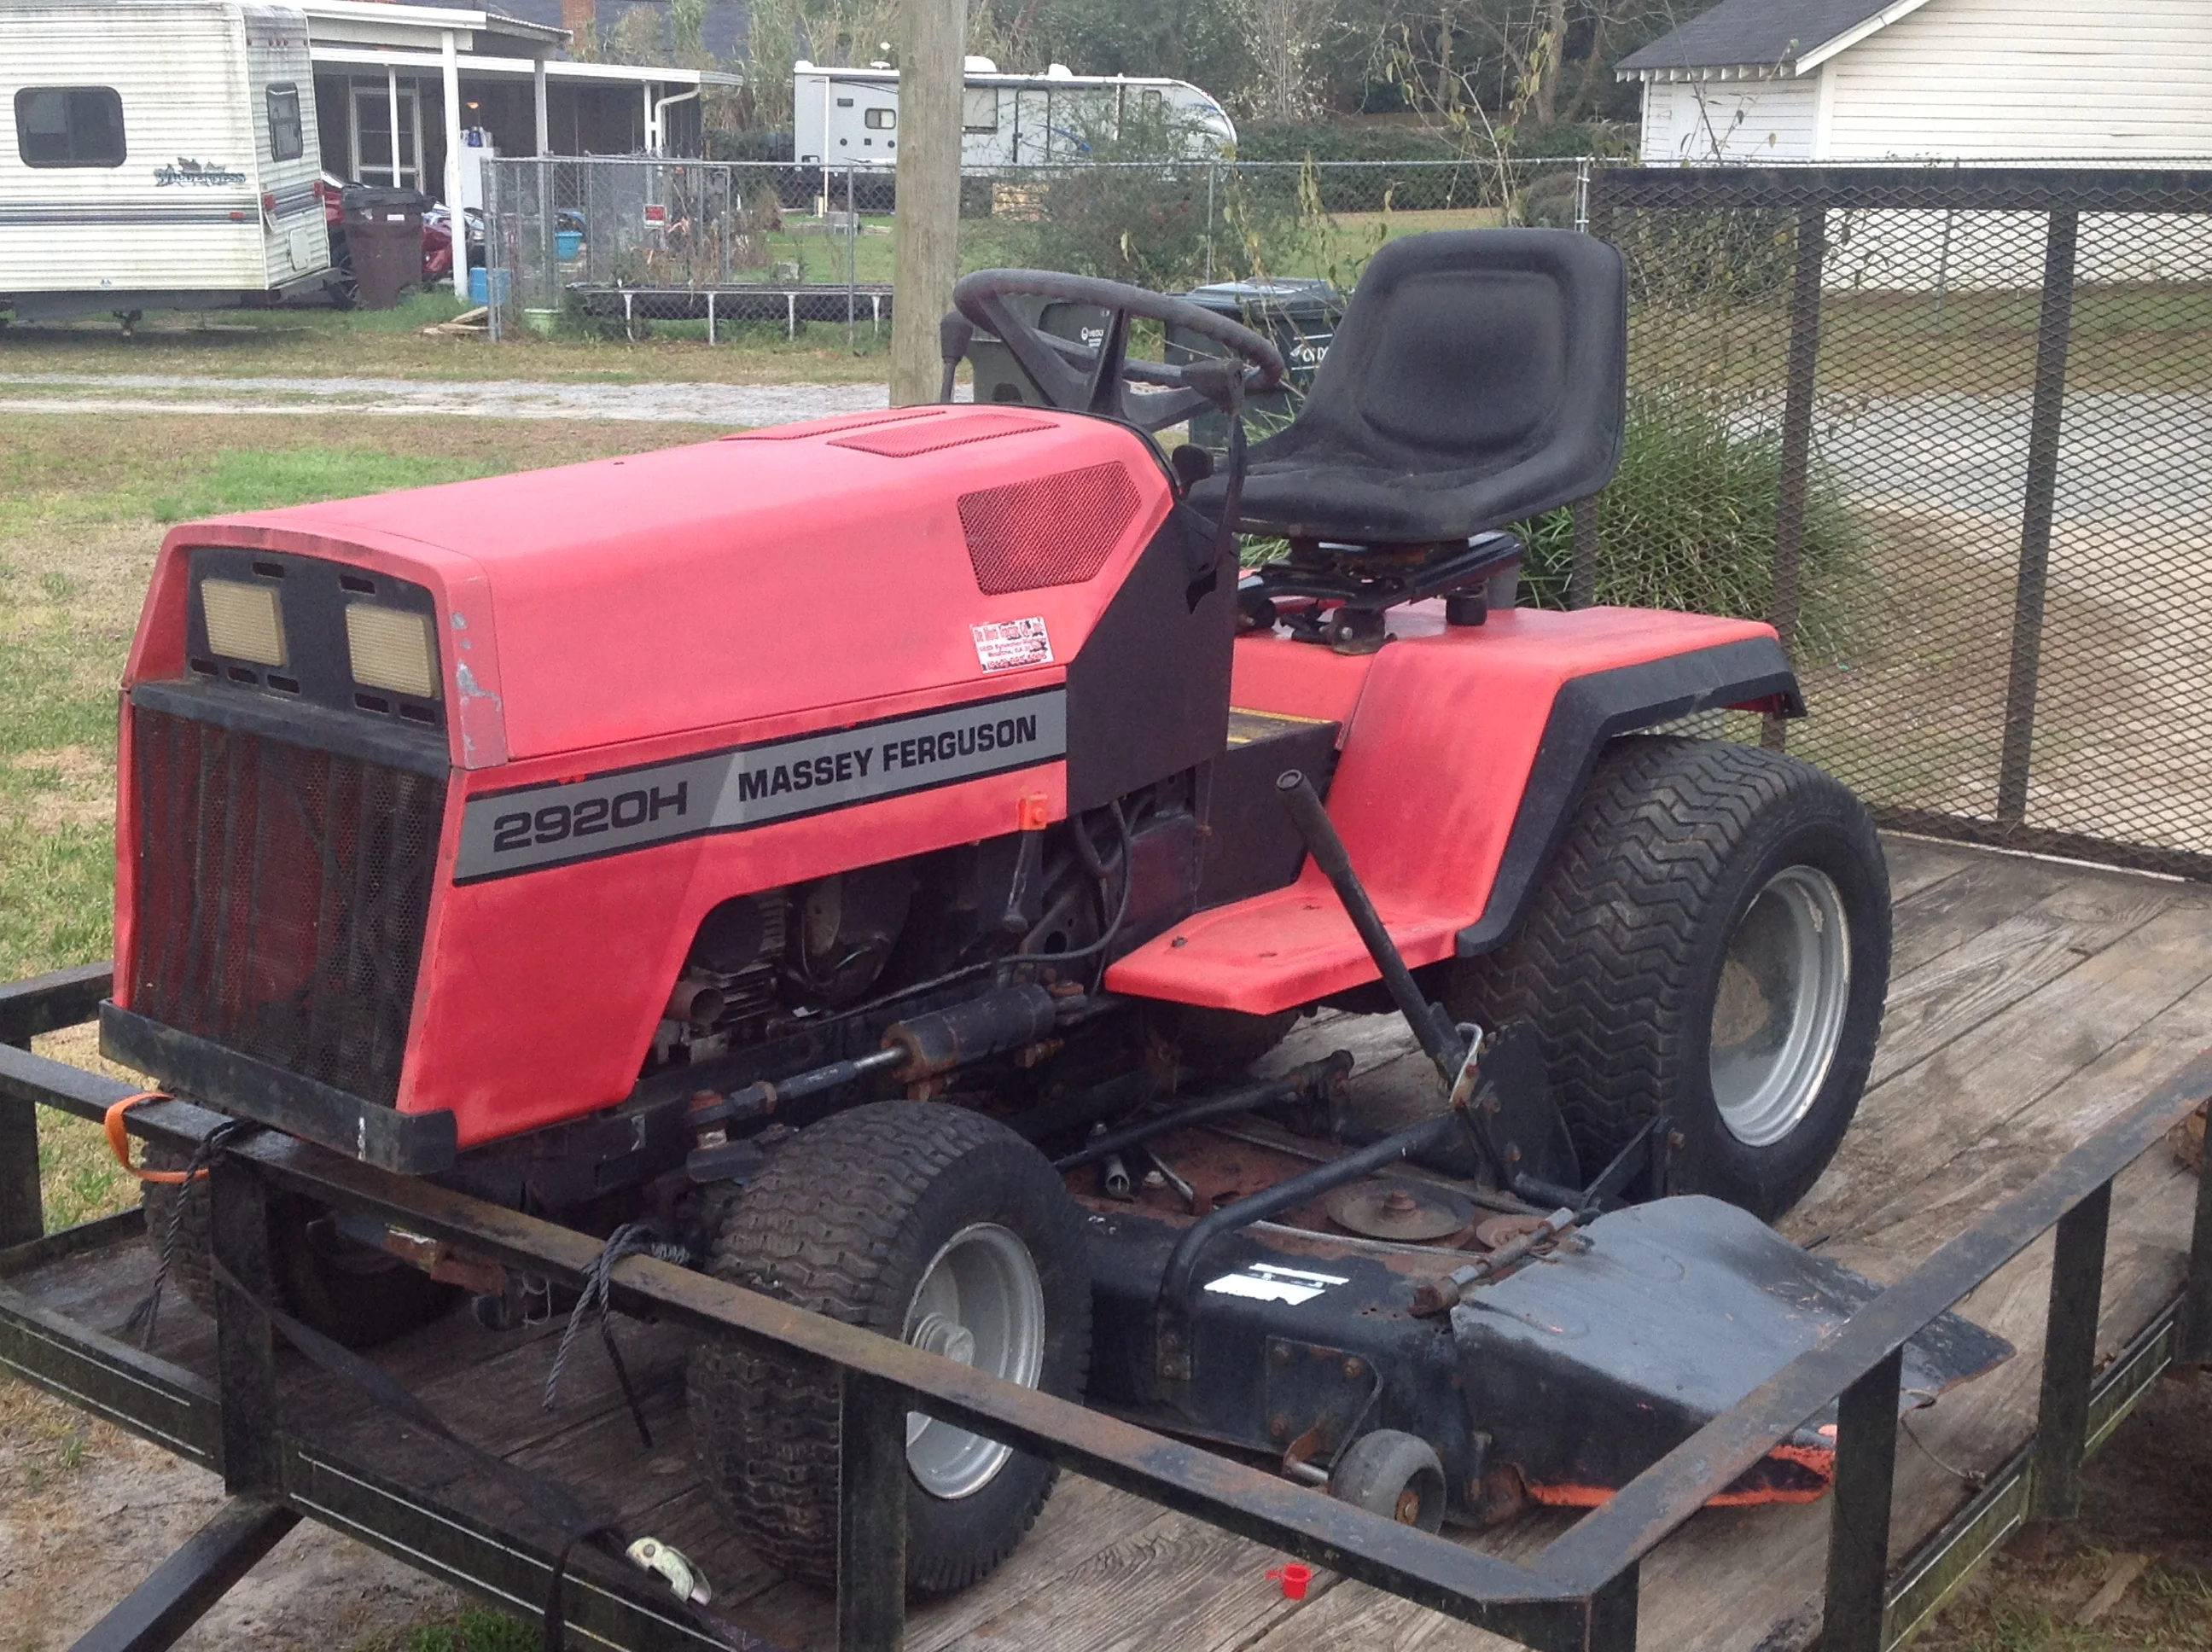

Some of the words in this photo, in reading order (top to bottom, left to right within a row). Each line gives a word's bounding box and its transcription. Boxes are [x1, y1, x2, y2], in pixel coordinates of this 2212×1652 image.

[738, 747, 873, 802] MASSEY
[883, 715, 1036, 771] FERGUSON
[493, 781, 688, 852] 2920H
